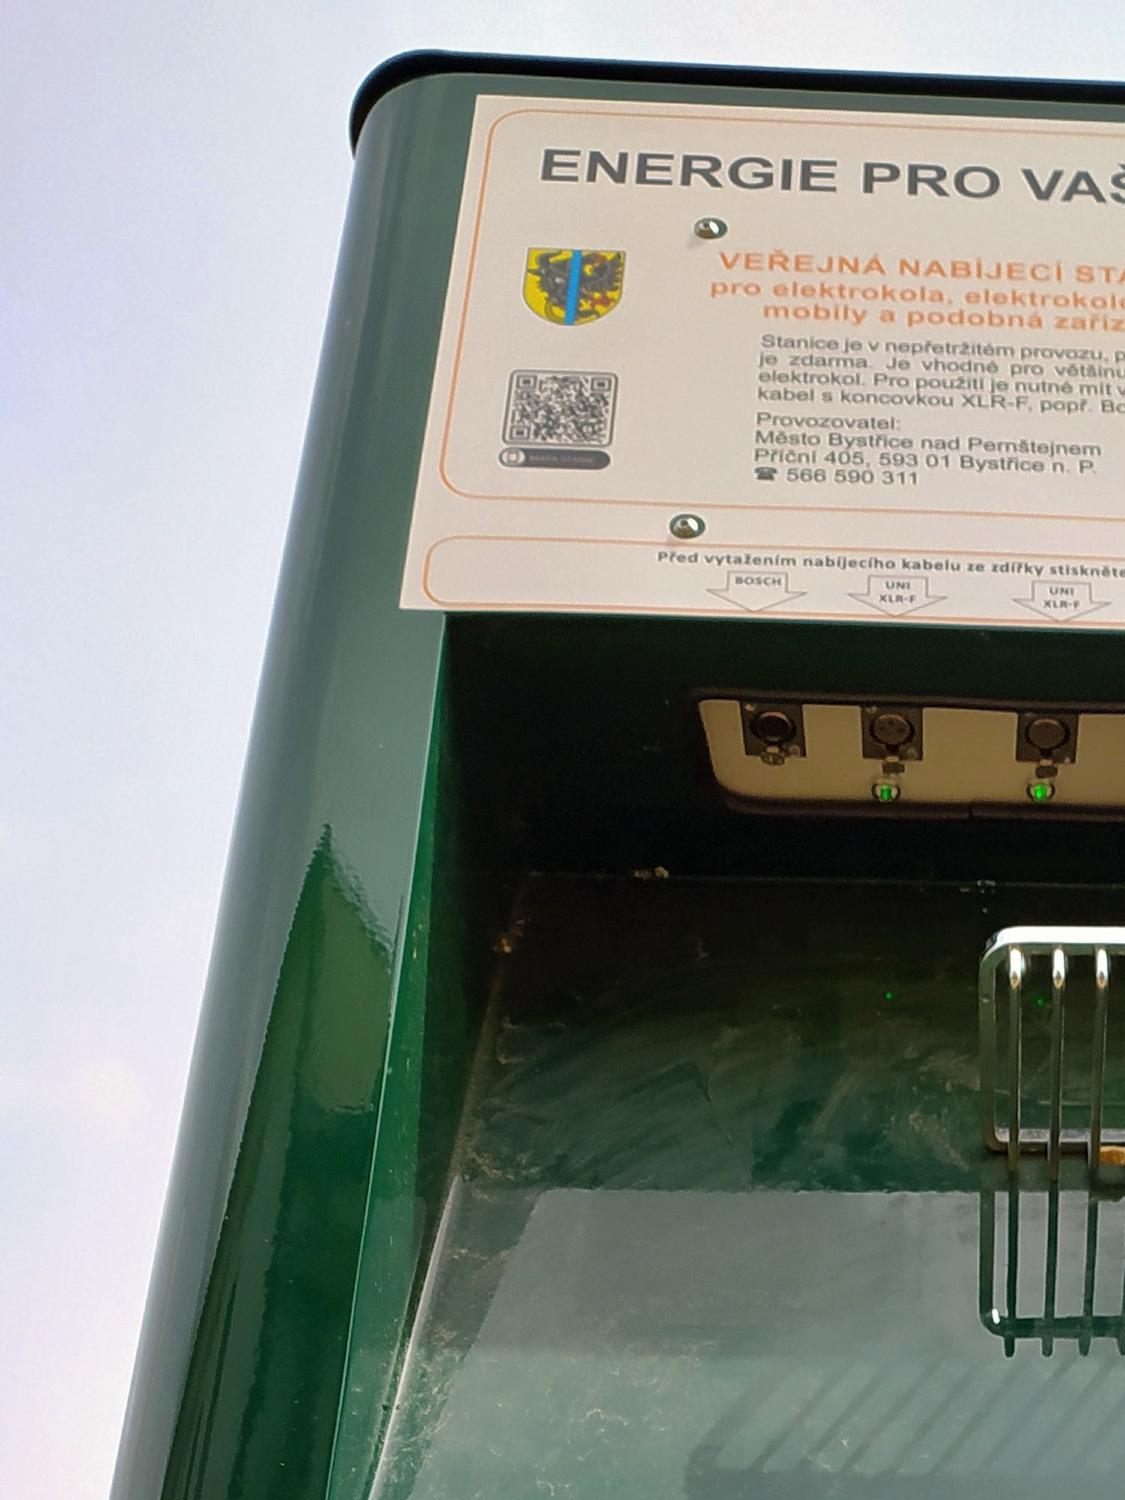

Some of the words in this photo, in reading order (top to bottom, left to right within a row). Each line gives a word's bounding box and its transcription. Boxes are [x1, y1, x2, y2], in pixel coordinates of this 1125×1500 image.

[540, 148, 838, 193] ENERGIE
[862, 161, 1000, 198] PRO
[719, 249, 886, 275] VEŘEJNÁ
[898, 257, 1063, 283] NABÍJECÍ
[710, 281, 761, 299] pro
[772, 281, 952, 305] elektrokola,
[762, 302, 867, 325] mobily
[879, 308, 896, 323] a
[906, 308, 1043, 329] podobná
[760, 333, 839, 350] Stanice
[844, 337, 863, 352] je
[868, 340, 879, 351] v
[885, 340, 1014, 357] nepřetržitém
[1020, 346, 1109, 363] provozu,
[759, 353, 777, 368] je
[789, 354, 872, 369] zdarma.
[886, 357, 910, 370] Je
[1011, 364, 1044, 377] pro
[758, 370, 865, 386] elektrokol.
[873, 373, 909, 387] Pro
[915, 376, 984, 391] použití
[991, 379, 1008, 393] je
[1015, 380, 1073, 395] nutné
[1079, 382, 1112, 396] mít
[758, 387, 814, 402] kabel
[822, 391, 833, 402] s
[840, 389, 953, 407] koncovkou
[961, 394, 1032, 411] XLR-F,
[1040, 398, 1093, 414] popř.
[756, 411, 900, 430] Provozovatel:
[755, 430, 820, 446] Město
[828, 432, 913, 449] Bystřice
[921, 436, 960, 450] nad
[967, 436, 1101, 456] Pernštejnem
[754, 448, 816, 464] Příční
[824, 451, 870, 467] 405,
[879, 453, 918, 467] 593
[926, 454, 950, 469] 01
[960, 455, 1044, 472] Bystřice
[1052, 461, 1070, 473] n.
[1079, 460, 1097, 474] P.
[786, 468, 826, 482] 566
[834, 469, 874, 484] 590
[882, 471, 918, 485] 311
[657, 551, 698, 564] Před
[704, 553, 797, 568] vytažením
[803, 556, 896, 571] nabíjecího
[902, 558, 961, 571] kabelu
[966, 562, 985, 572] ze
[992, 560, 1043, 576] zdířky
[735, 576, 782, 586] BOSCH
[885, 580, 911, 591] UNI
[1049, 586, 1074, 596] UNI
[879, 594, 917, 604] XLR-F
[1043, 599, 1080, 609] XLR-F
